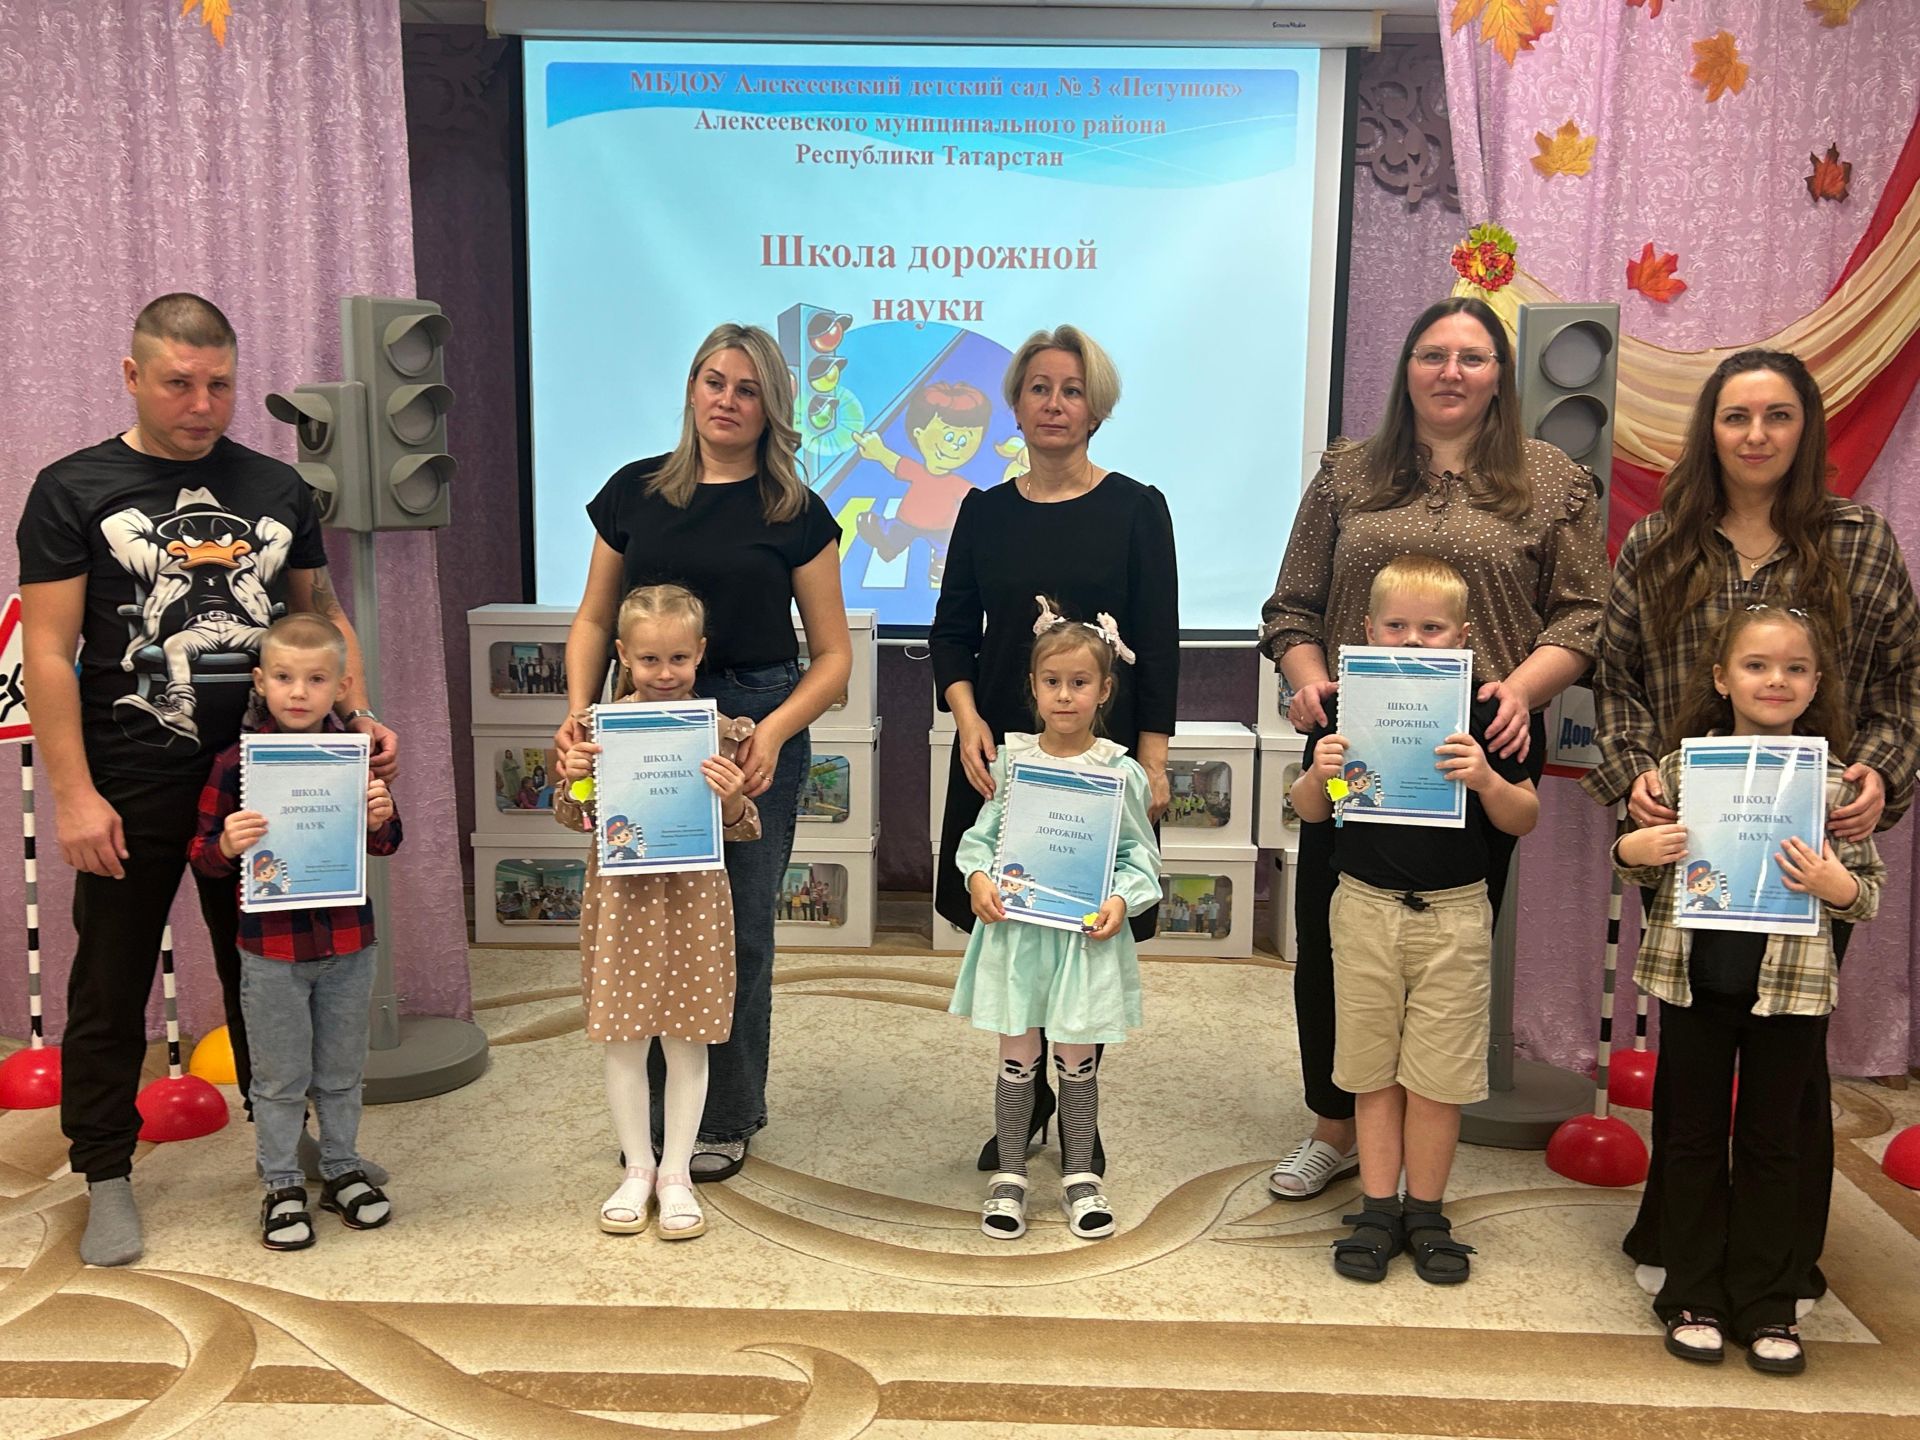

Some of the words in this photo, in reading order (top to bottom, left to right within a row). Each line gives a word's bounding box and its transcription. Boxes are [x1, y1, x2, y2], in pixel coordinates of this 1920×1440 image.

[630, 70, 727, 96] МБДОУ
[735, 74, 902, 96] Алексеевский
[907, 76, 1004, 98] детский
[1009, 79, 1049, 98] сад
[1055, 76, 1082, 97] №
[1088, 76, 1102, 97] 3
[1109, 76, 1243, 101] «Петушок»
[694, 109, 868, 132] Алексеевского
[875, 115, 1076, 137] муниципального
[1082, 113, 1167, 138] района
[795, 143, 934, 169] Республики
[942, 145, 1064, 171] Татарстан
[760, 233, 896, 268] Школа
[907, 239, 1098, 279] дорожной
[872, 297, 985, 330] науки
[1387, 702, 1429, 712] ШКОЛА
[1374, 718, 1440, 729] ДОРОЖНЫХ
[1560, 717, 1593, 749] Дор
[1391, 736, 1422, 745] НАУК
[643, 754, 683, 763] ШКОЛА
[632, 769, 694, 781] ДОРОЖНЫХ
[291, 788, 331, 797] ШКОЛА
[649, 786, 679, 796] НАУК
[280, 804, 342, 815] ДОРОЖНЫХ
[1048, 810, 1086, 824] ШКОЛА
[1719, 813, 1793, 824] ДОРОЖНЫХ
[296, 821, 325, 831] НАУК
[1035, 825, 1096, 842] ДОРОЖНЫХ
[1738, 832, 1774, 842] НАУК
[1049, 843, 1077, 855] НАУК
